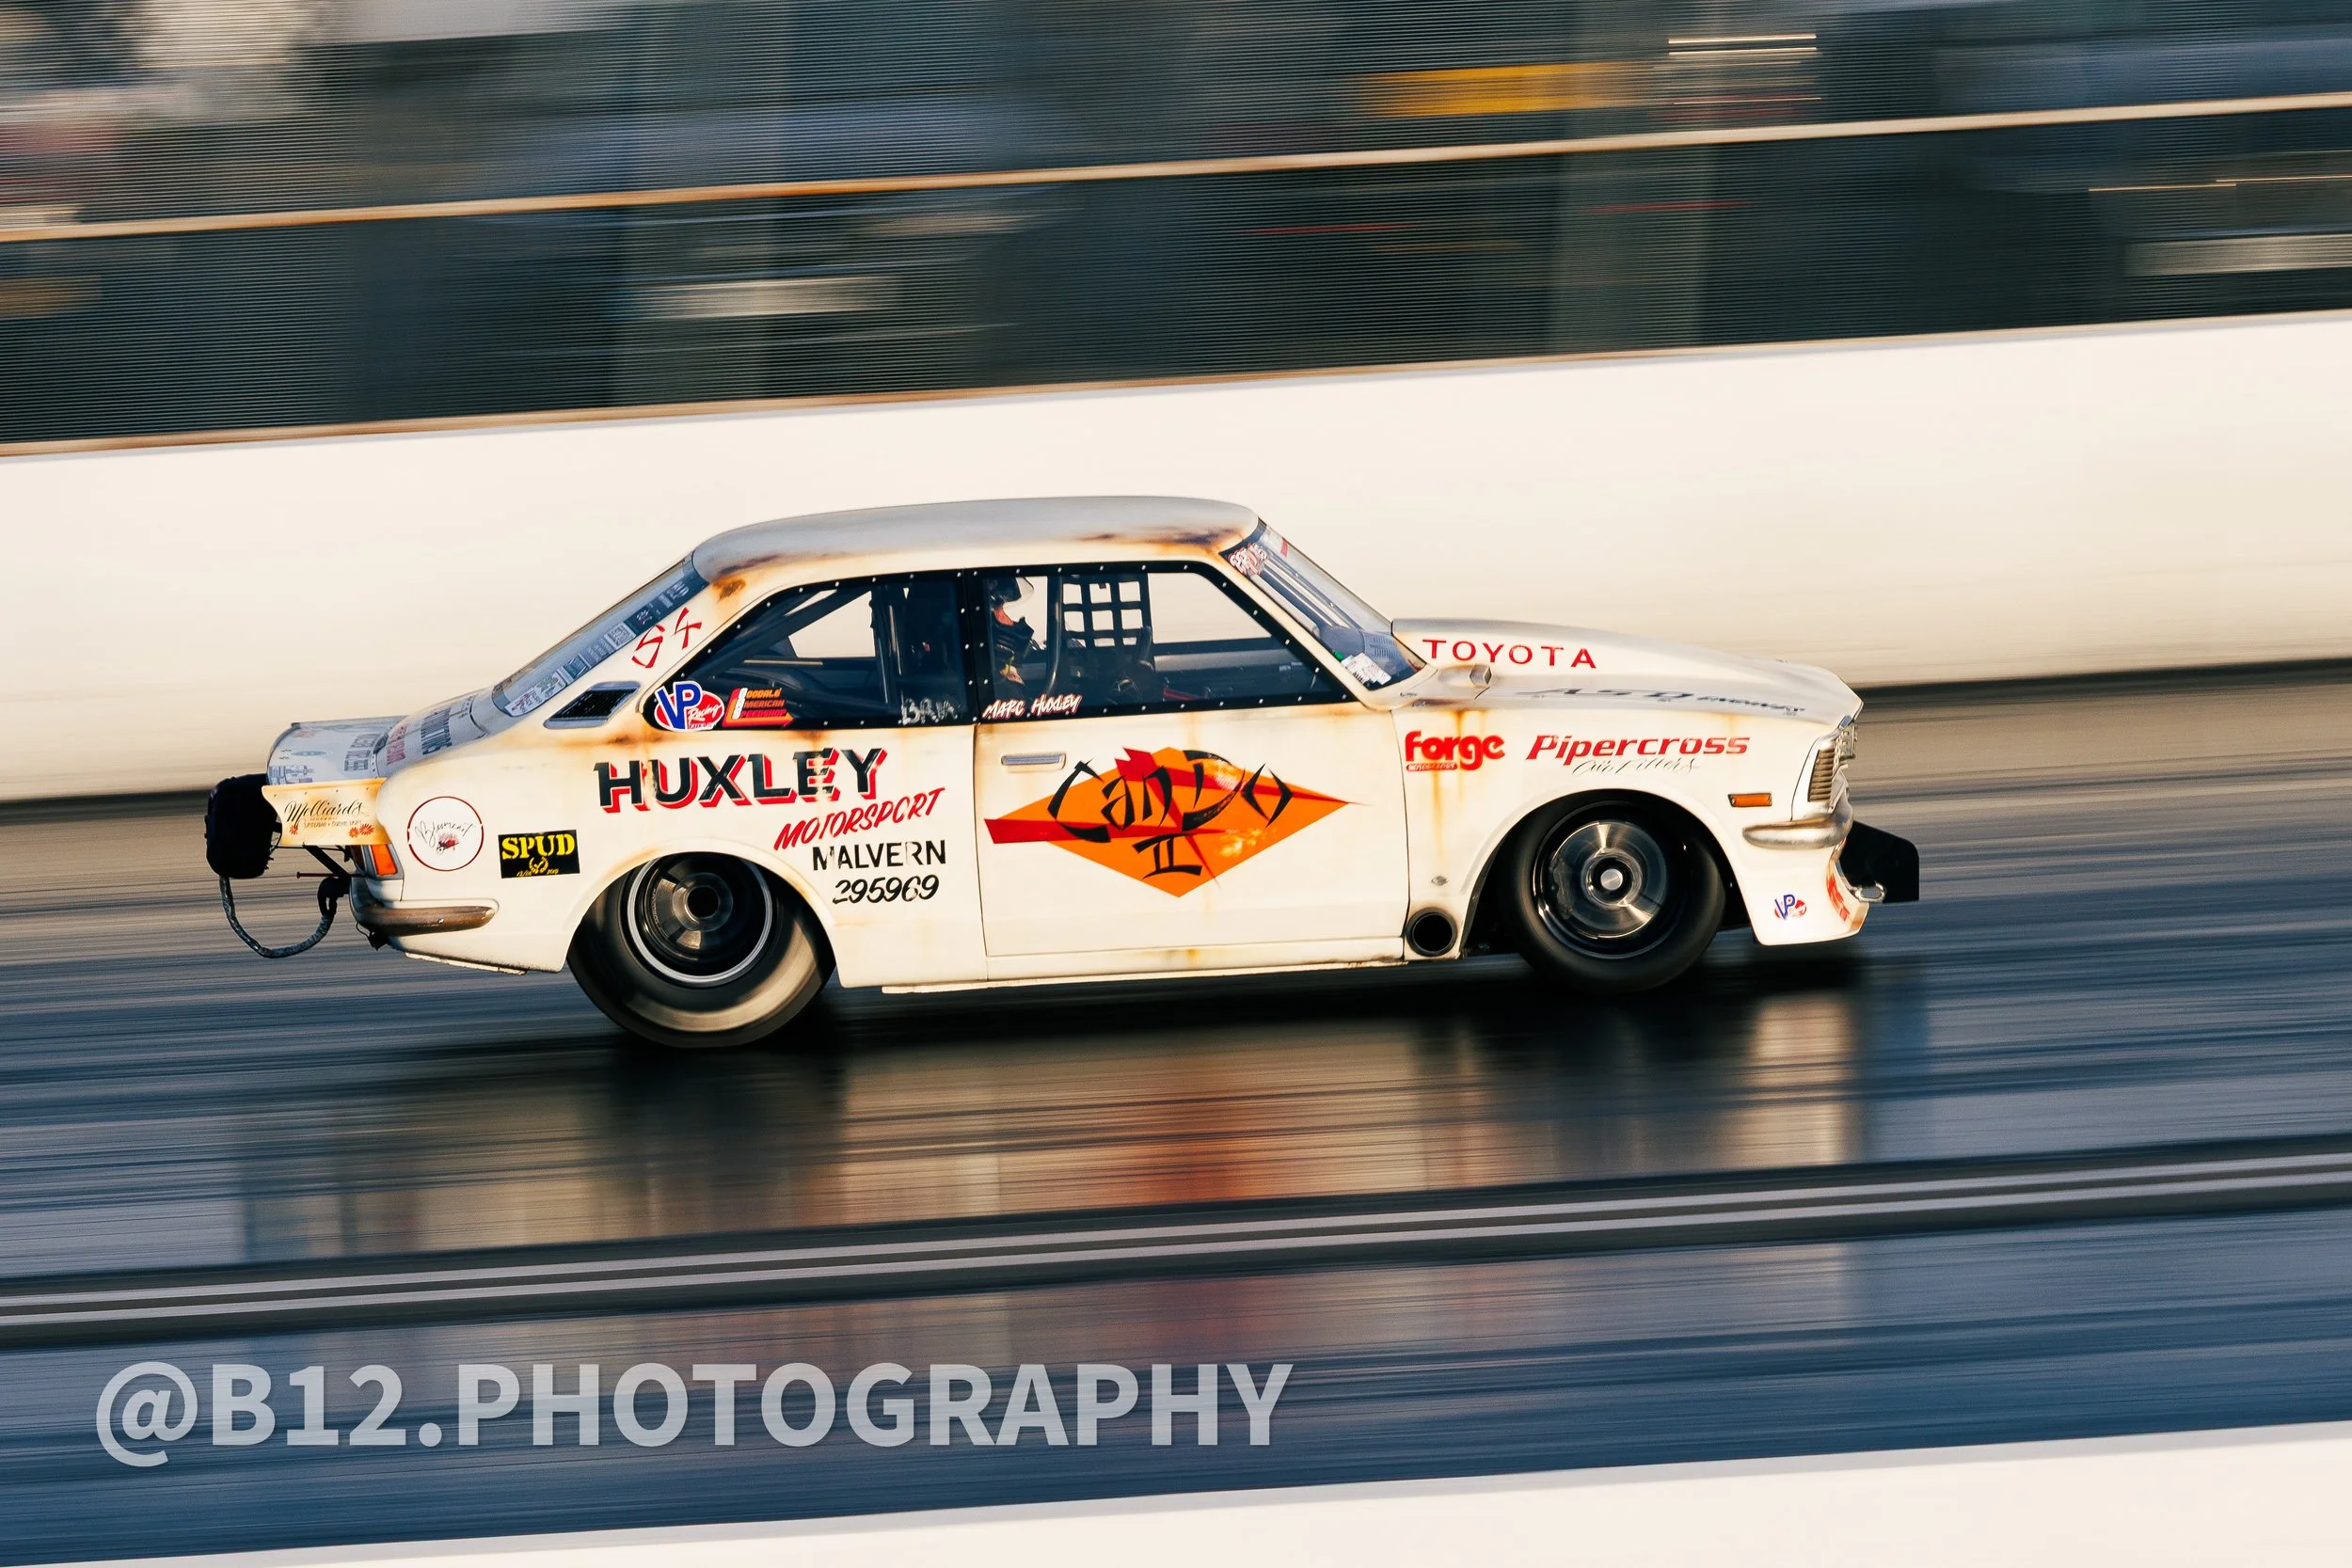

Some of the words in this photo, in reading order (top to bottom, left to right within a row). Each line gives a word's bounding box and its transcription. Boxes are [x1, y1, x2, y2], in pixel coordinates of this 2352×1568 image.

[1422, 639, 1597, 670] TOYOTA
[655, 682, 702, 730] VP
[688, 704, 722, 721] Racing
[981, 698, 1025, 720] MARC
[1030, 692, 1083, 718] HUXLEY
[1405, 730, 1505, 771] forge
[1525, 734, 1751, 767] Pipercross
[594, 748, 888, 813] HUXLEY
[773, 787, 946, 851] MOTORSPORT
[501, 833, 576, 861] SPUD
[812, 839, 947, 871] MALVERN
[832, 874, 940, 905] 295969
[1774, 895, 1796, 920] VP
